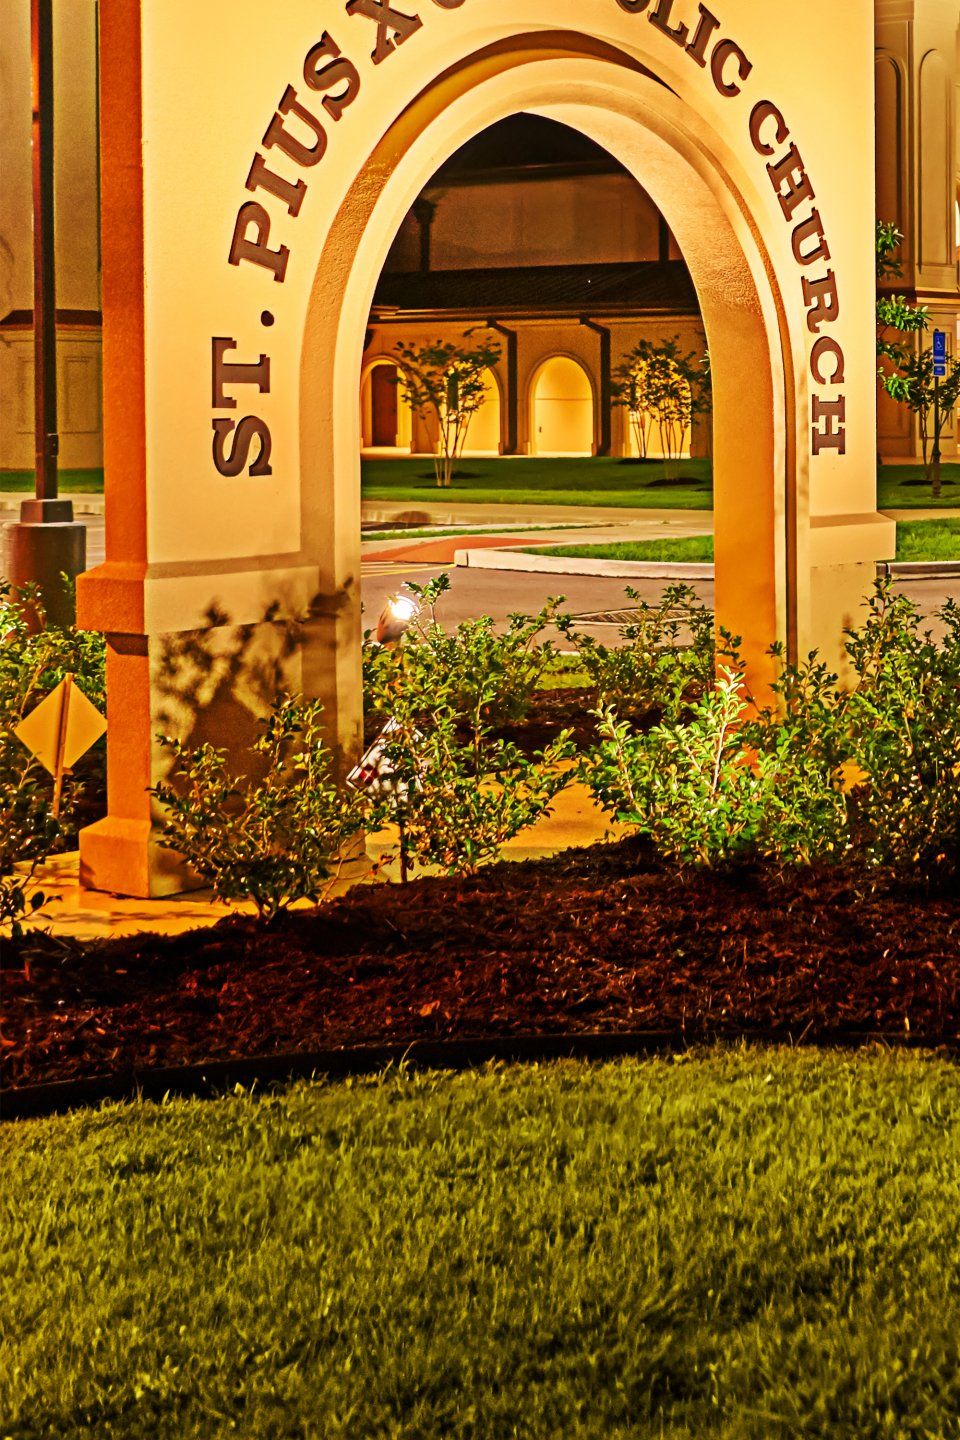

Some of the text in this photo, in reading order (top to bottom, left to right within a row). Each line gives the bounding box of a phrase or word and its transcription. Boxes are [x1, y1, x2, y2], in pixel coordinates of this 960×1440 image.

[228, 30, 361, 283] PIUS
[748, 99, 847, 456] CHURCH
[211, 309, 275, 478] ST.
